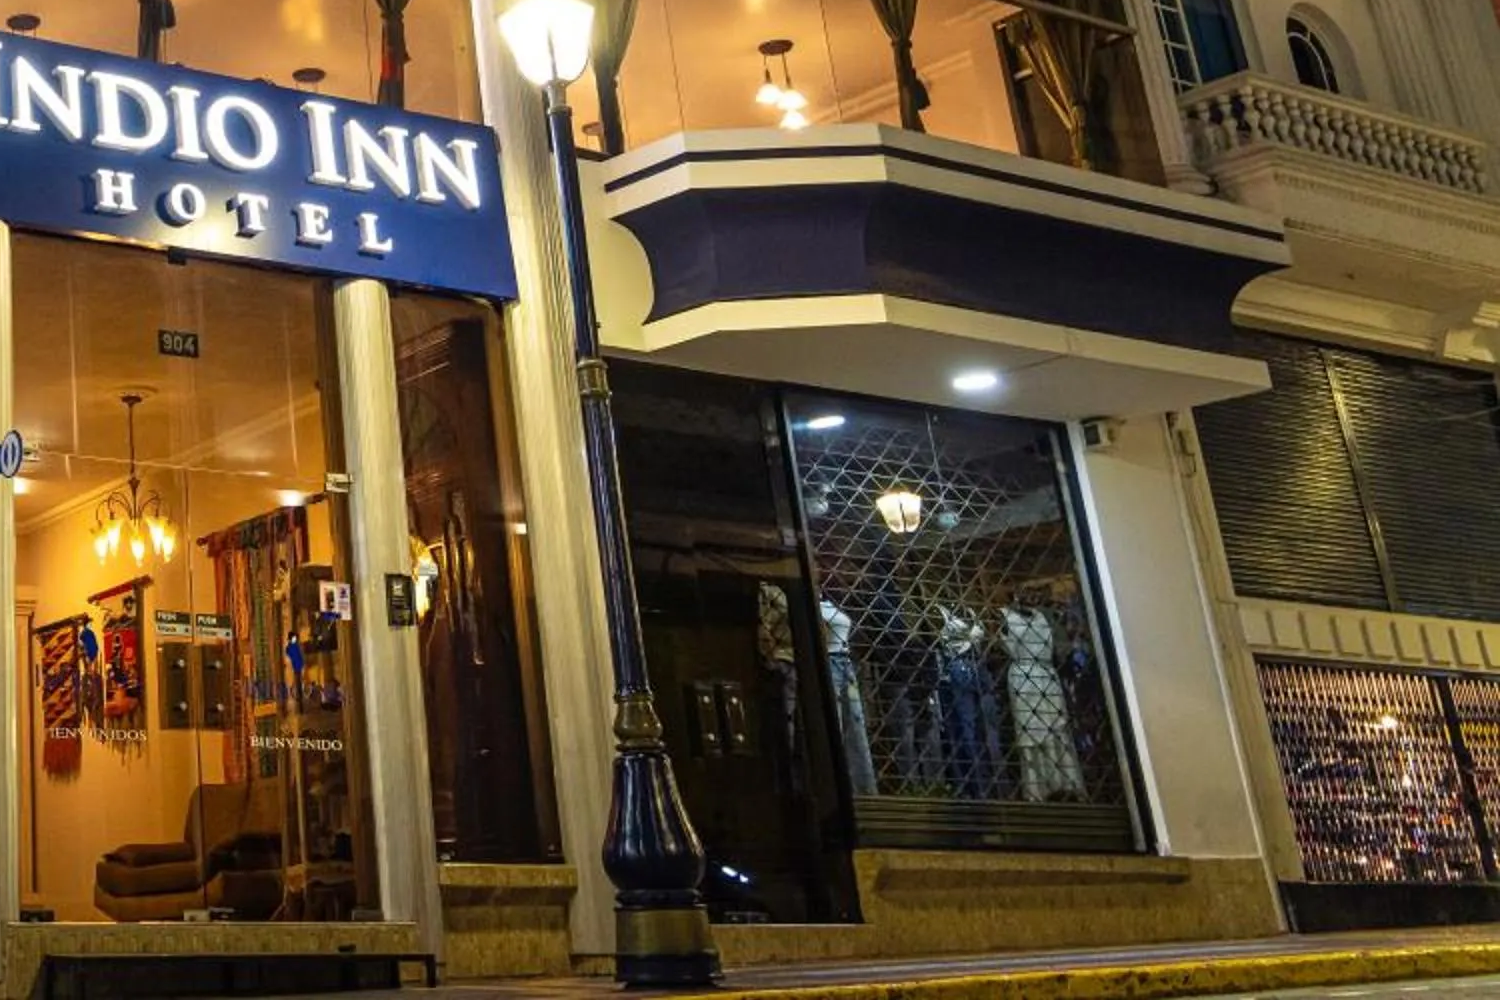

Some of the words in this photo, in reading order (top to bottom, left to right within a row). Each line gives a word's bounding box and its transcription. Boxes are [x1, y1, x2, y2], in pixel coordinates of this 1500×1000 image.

[299, 100, 482, 210] INN
[93, 168, 394, 256] HOTEL
[162, 332, 196, 354] 904
